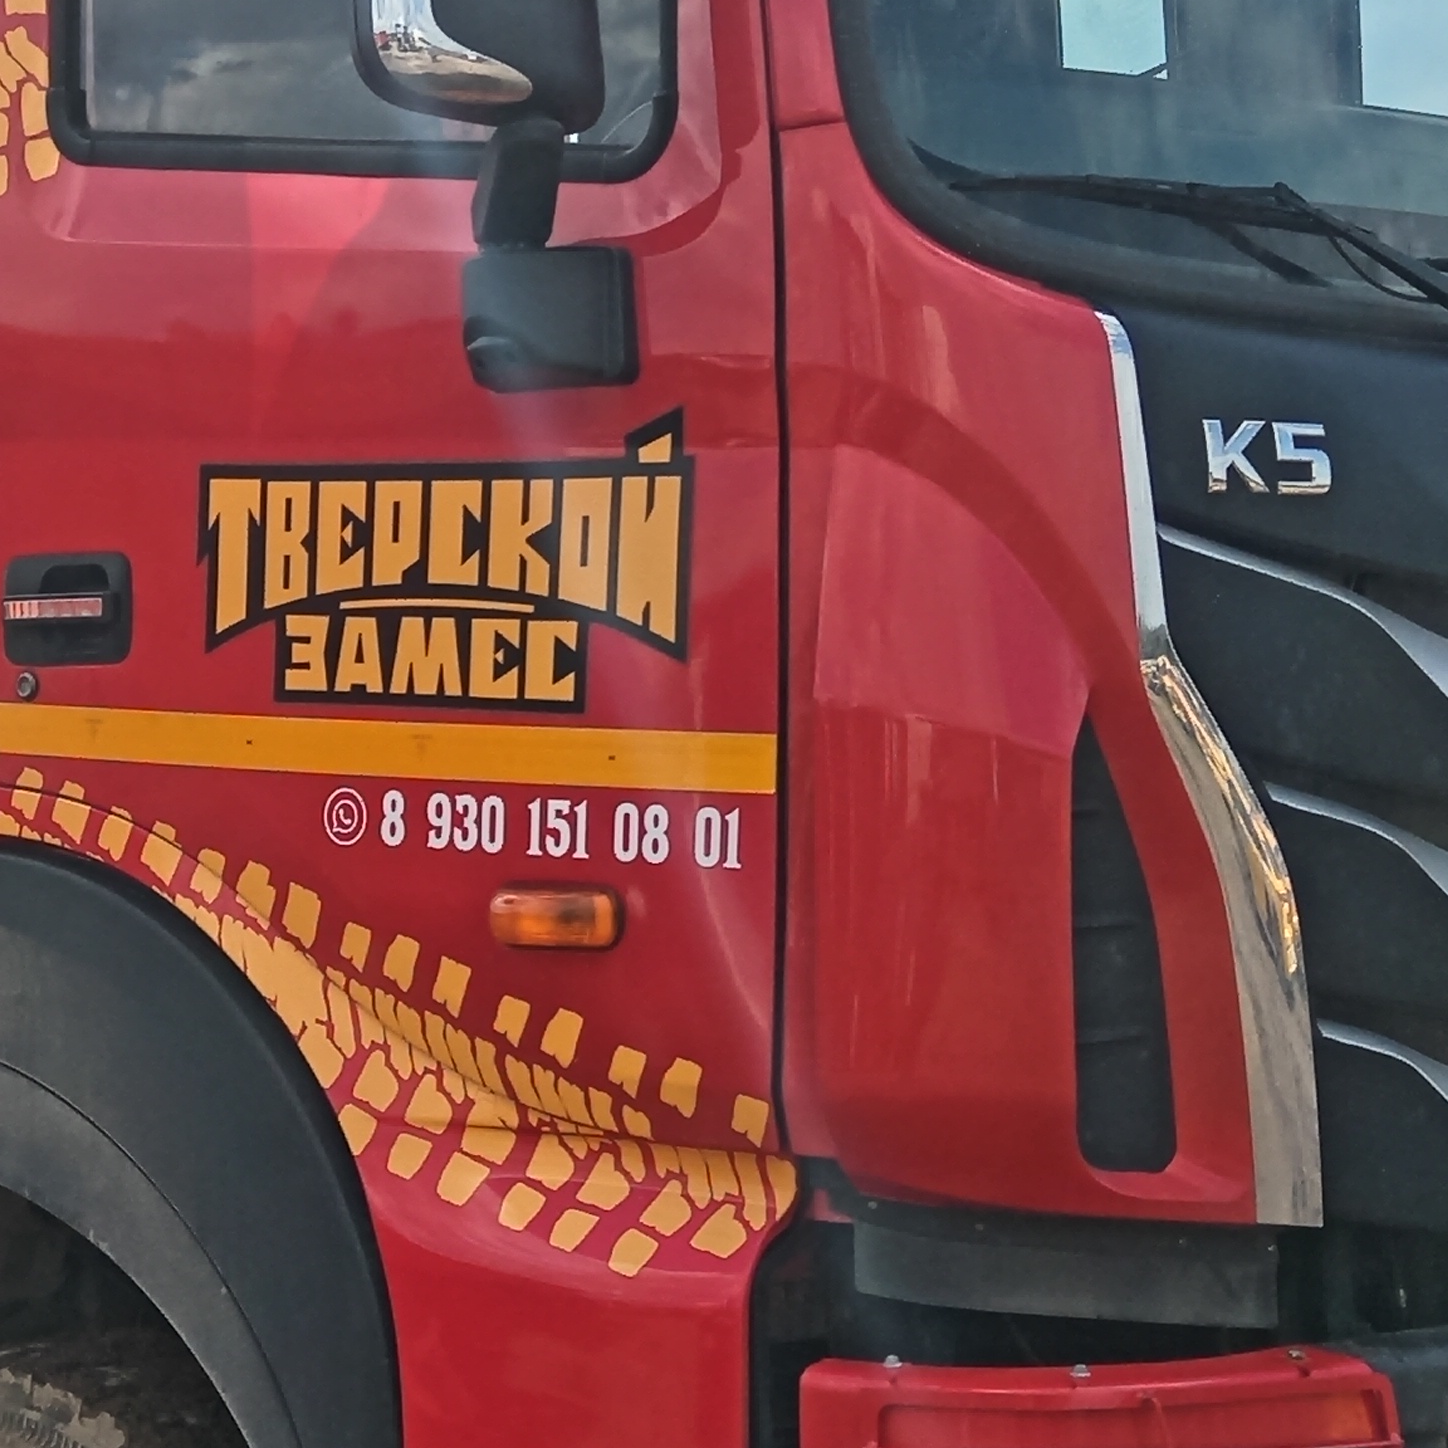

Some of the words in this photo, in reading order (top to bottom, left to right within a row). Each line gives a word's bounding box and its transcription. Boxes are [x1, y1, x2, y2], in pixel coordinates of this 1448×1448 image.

[1202, 418, 1333, 496] K5
[207, 432, 682, 644] ТВЕРСКОЙ
[284, 614, 579, 702] ЗАМЕС
[379, 788, 406, 847] 8
[426, 793, 505, 853] 930
[526, 797, 591, 859] 151
[613, 802, 670, 865] 08
[694, 806, 743, 870] 01
